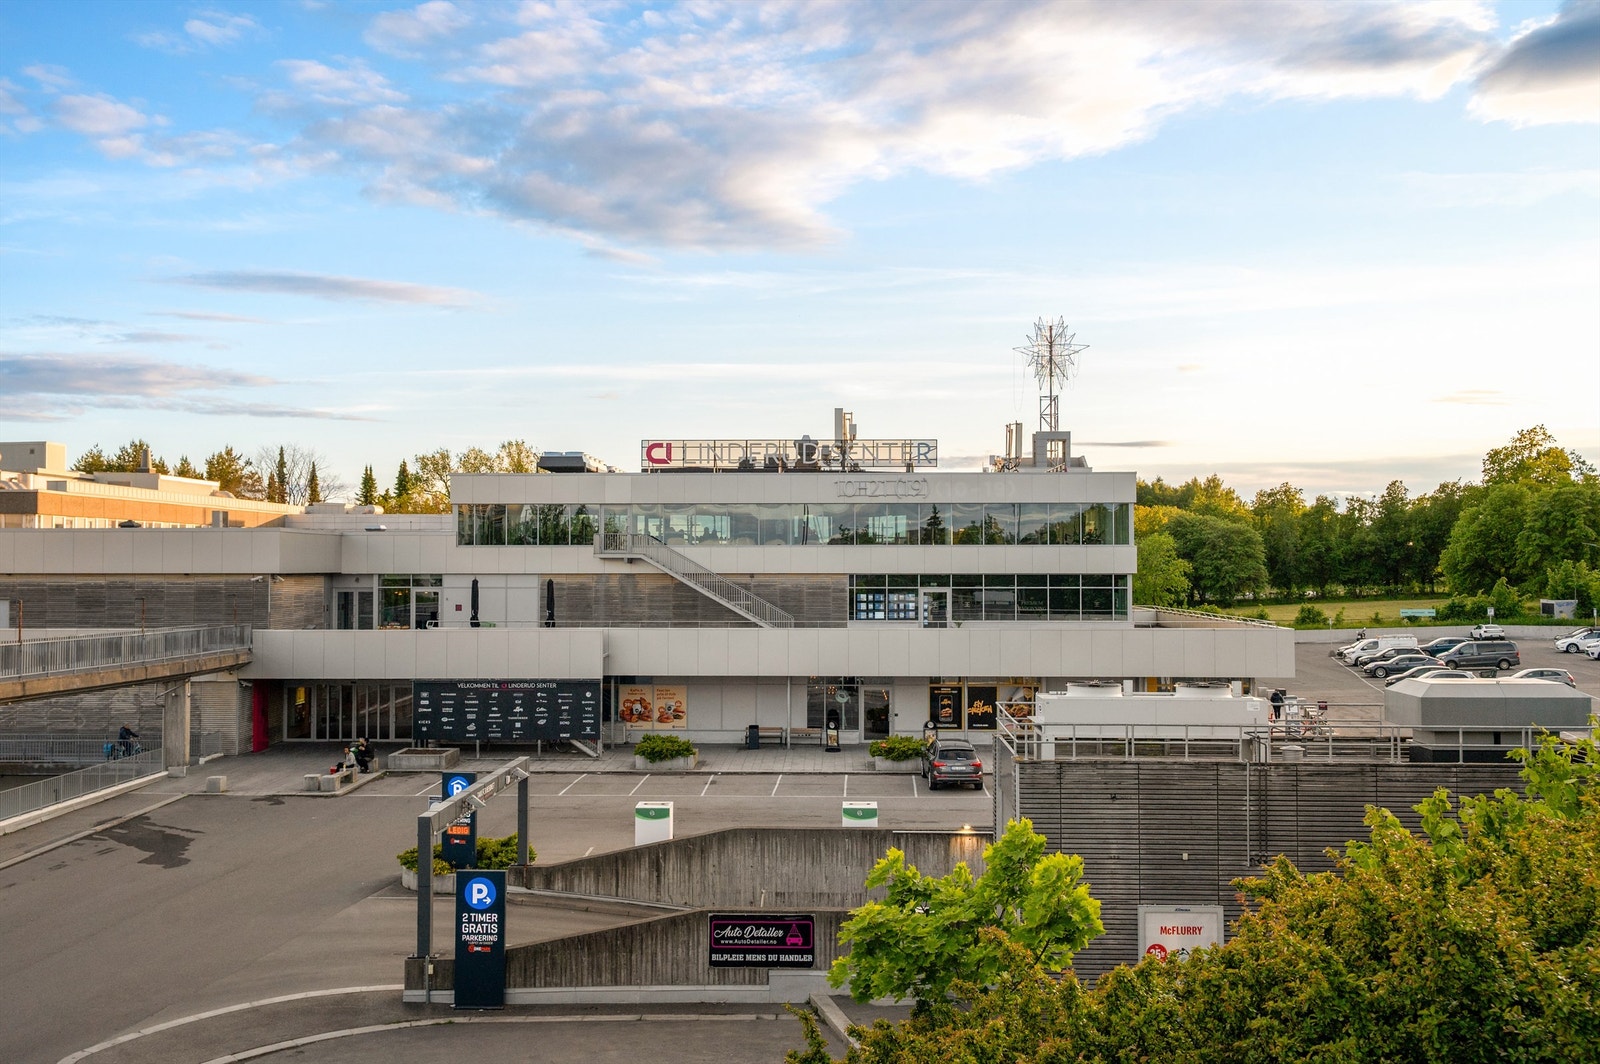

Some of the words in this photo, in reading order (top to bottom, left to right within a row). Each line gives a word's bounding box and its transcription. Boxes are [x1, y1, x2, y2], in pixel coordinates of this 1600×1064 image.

[684, 443, 820, 465] LINDERUD
[831, 442, 932, 465] SENTER
[462, 913, 468, 922] 2
[470, 913, 498, 922] TIMER
[462, 923, 498, 933] GRATIS
[714, 925, 742, 938] Auto
[743, 925, 784, 938] Detailer
[1160, 926, 1203, 935] McFLURRY
[745, 954, 766, 962] MENS
[768, 954, 778, 962] DU
[779, 954, 813, 962] HANDLER
